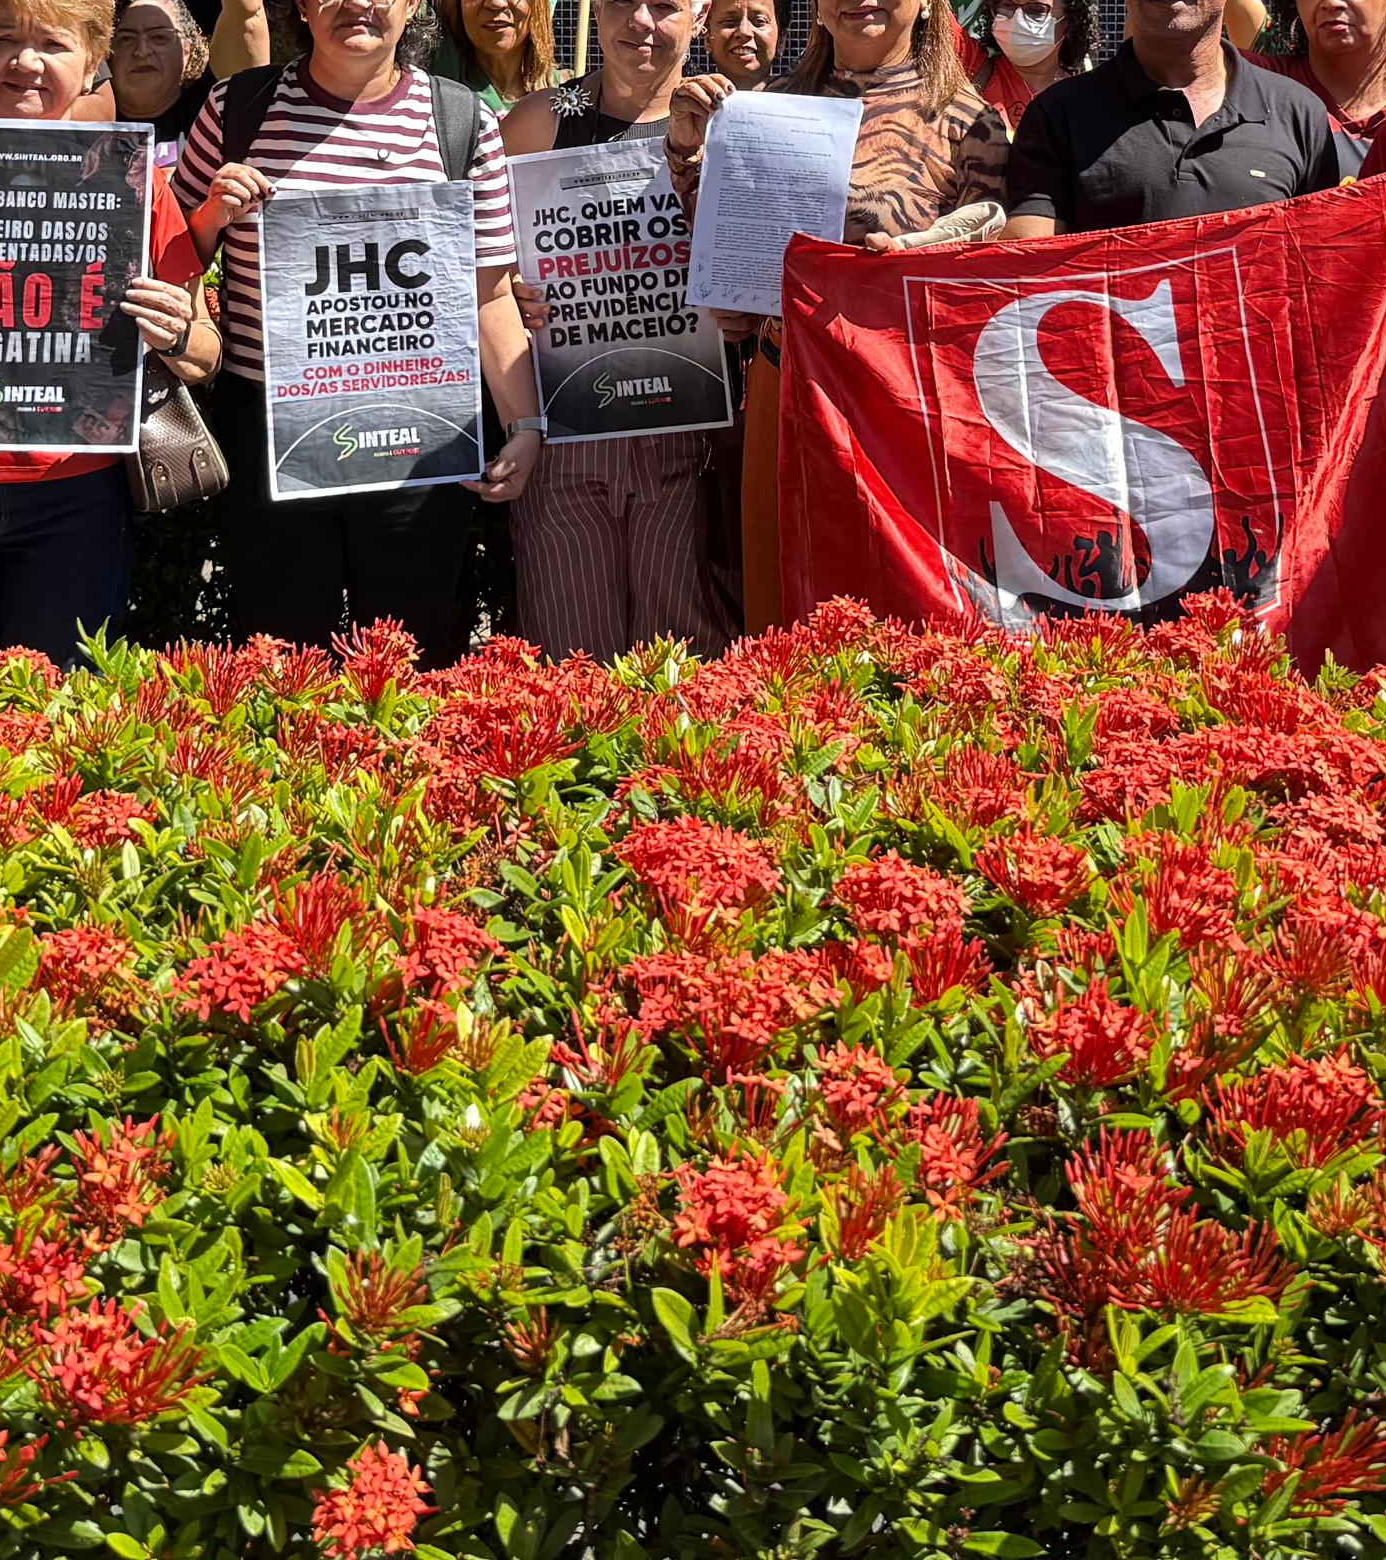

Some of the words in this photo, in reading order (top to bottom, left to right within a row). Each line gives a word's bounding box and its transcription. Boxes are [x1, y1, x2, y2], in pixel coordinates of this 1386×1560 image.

[53, 191, 122, 210] MASTER:
[532, 206, 578, 227] JHC,
[580, 197, 645, 222] QUEM
[651, 192, 685, 211] VA
[41, 220, 109, 241] DAS/OS
[534, 220, 643, 254] COBRIR
[647, 214, 689, 240] OS
[305, 240, 432, 296] JHC
[537, 241, 692, 281] PREJUÍZOS
[80, 260, 106, 330] É
[544, 282, 576, 302] AO
[581, 272, 658, 298] FUNDO
[306, 295, 399, 316] APOSTOU
[404, 292, 434, 309] NO
[306, 310, 434, 338] MERCADO
[549, 326, 582, 349] DE
[588, 312, 699, 344] MACEIÓ?
[307, 334, 435, 359] FINANCEIRO
[276, 379, 338, 398] DOS/AS
[341, 369, 471, 393] SERVIDORES/AS!
[302, 365, 343, 381] COM
[347, 363, 359, 376] O
[364, 357, 444, 375] DINHEIRO
[593, 372, 672, 409] SINTEAL
[332, 423, 421, 462] SINTEAL
